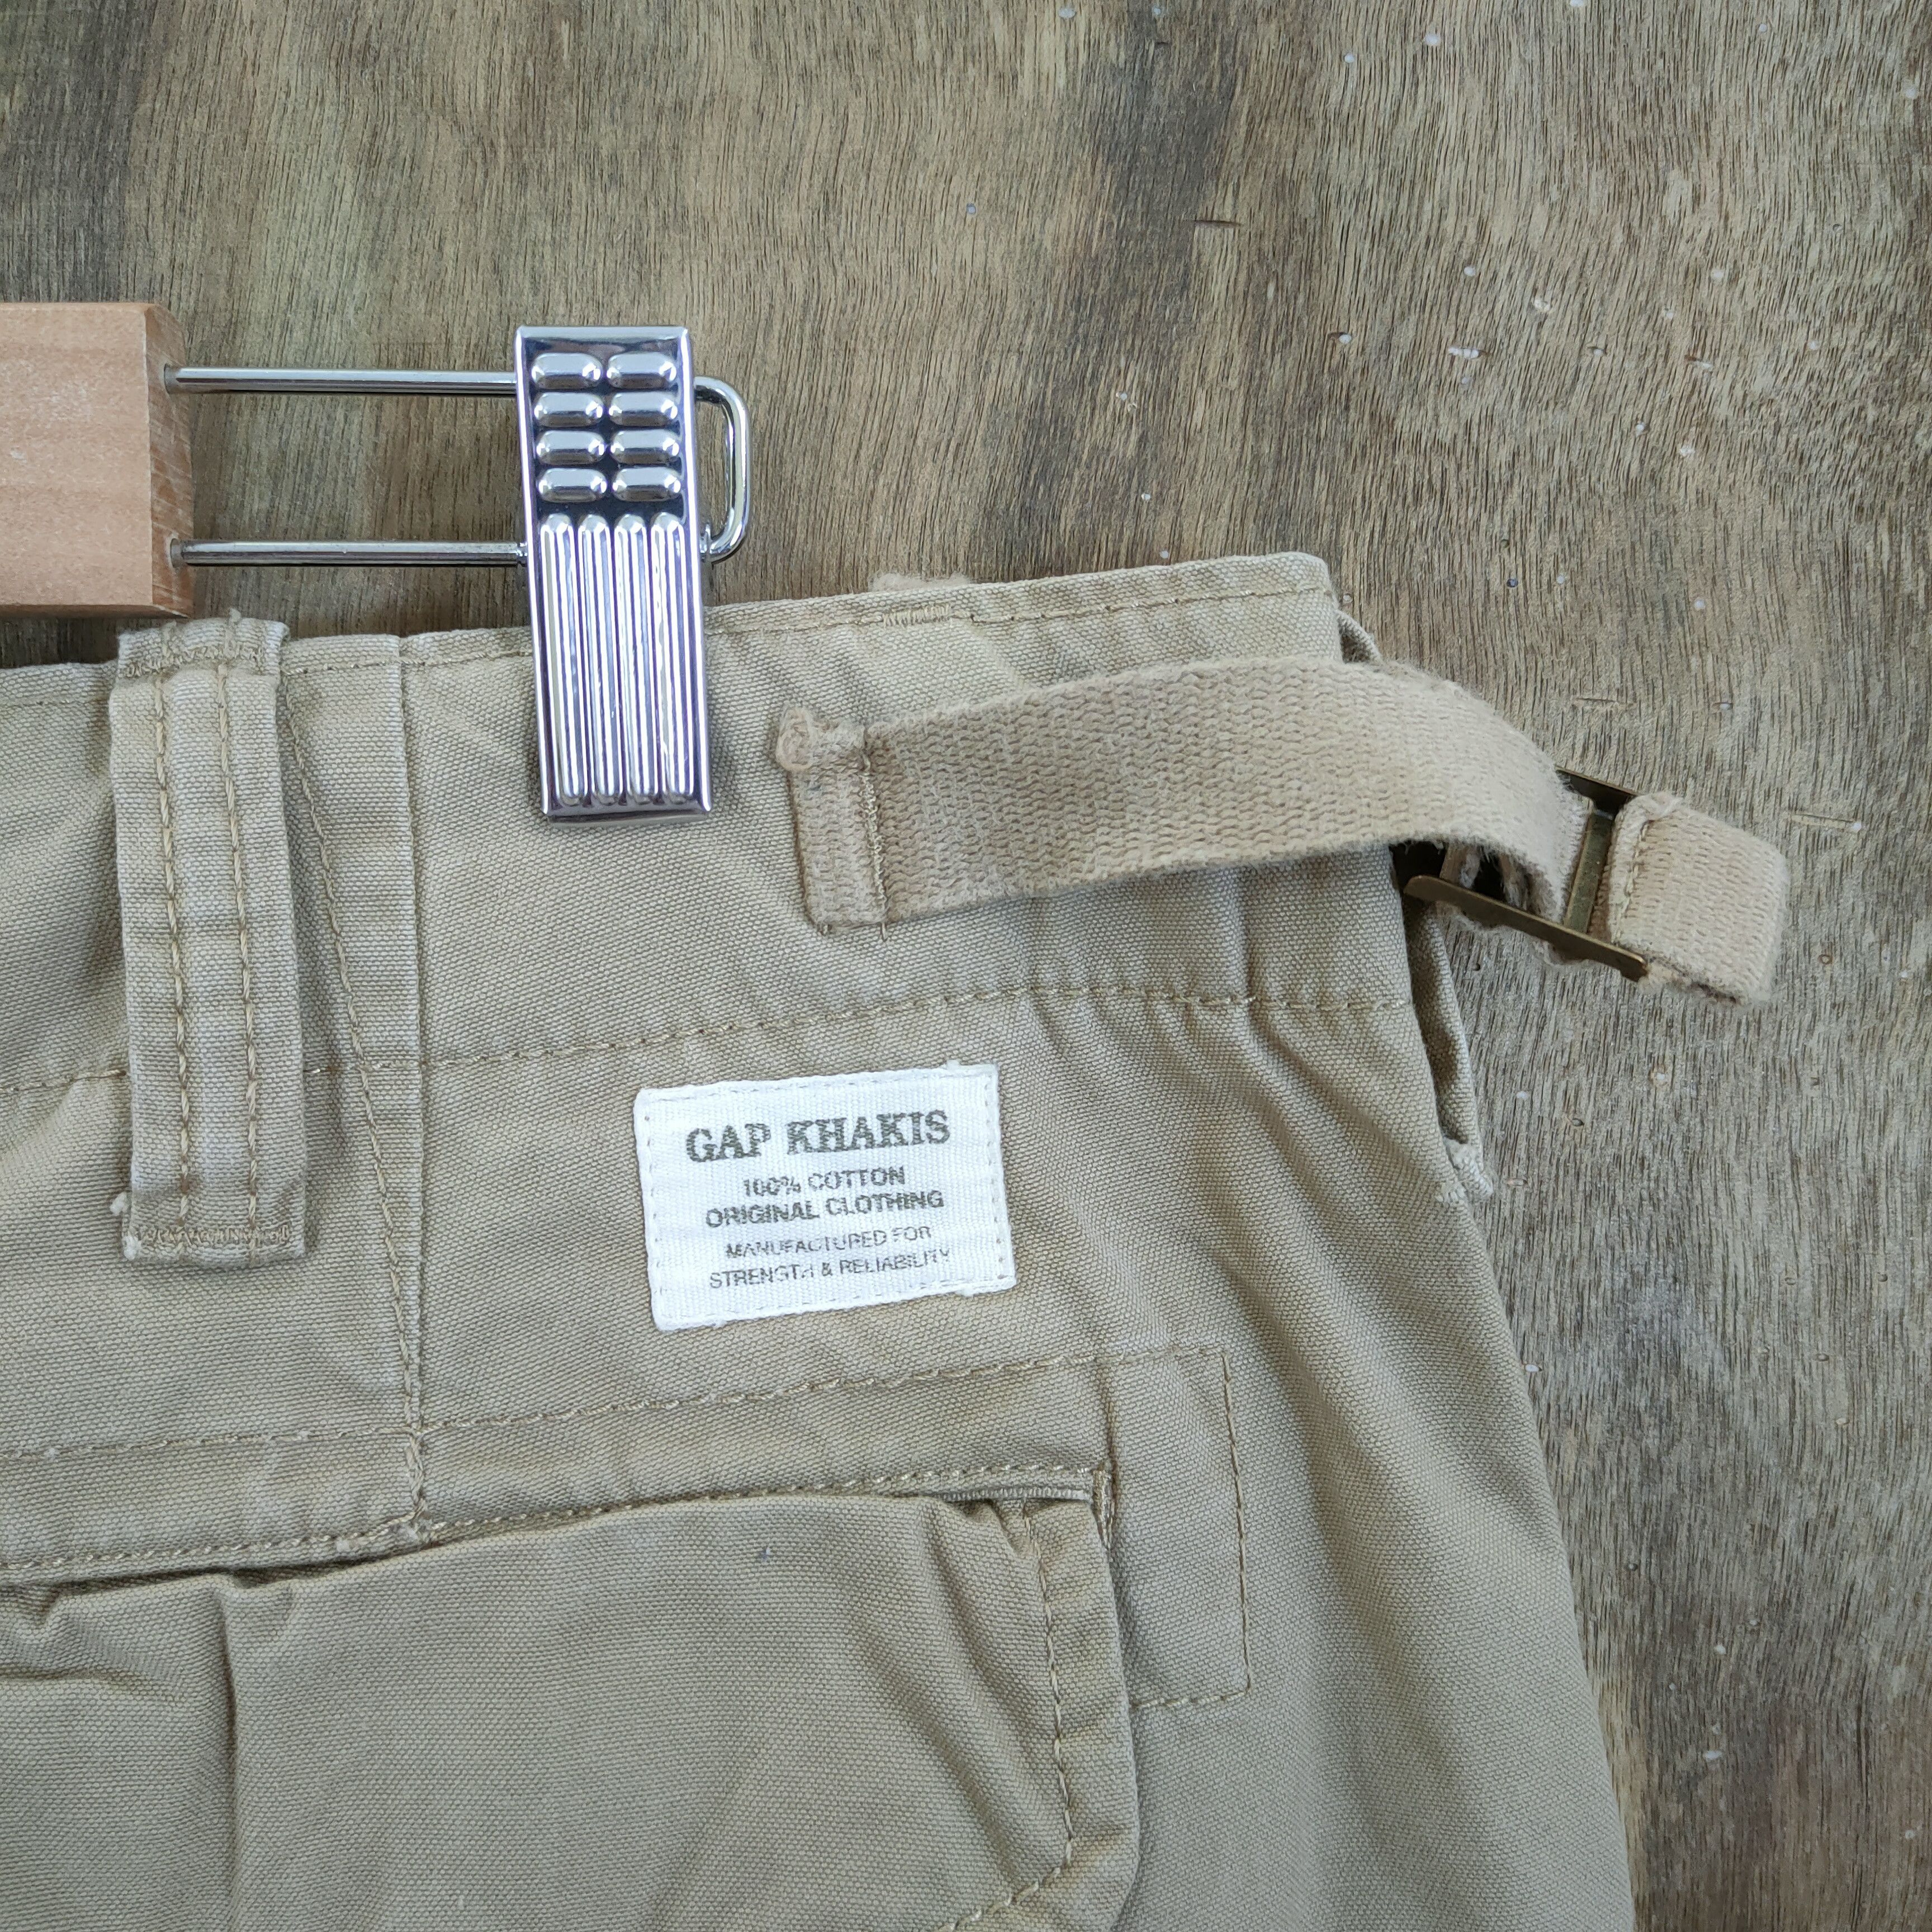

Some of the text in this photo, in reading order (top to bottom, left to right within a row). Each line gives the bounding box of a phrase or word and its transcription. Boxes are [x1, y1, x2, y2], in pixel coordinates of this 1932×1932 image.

[686, 1110, 950, 1163] GAP KHAKIS
[743, 1166, 906, 1197] 100% COTTON
[705, 1190, 945, 1228] ORIGINAL CLOTHING
[726, 1226, 932, 1258] MANUFACTURED FOR
[709, 1248, 950, 1289] STRENGTH & RELIABILITY
